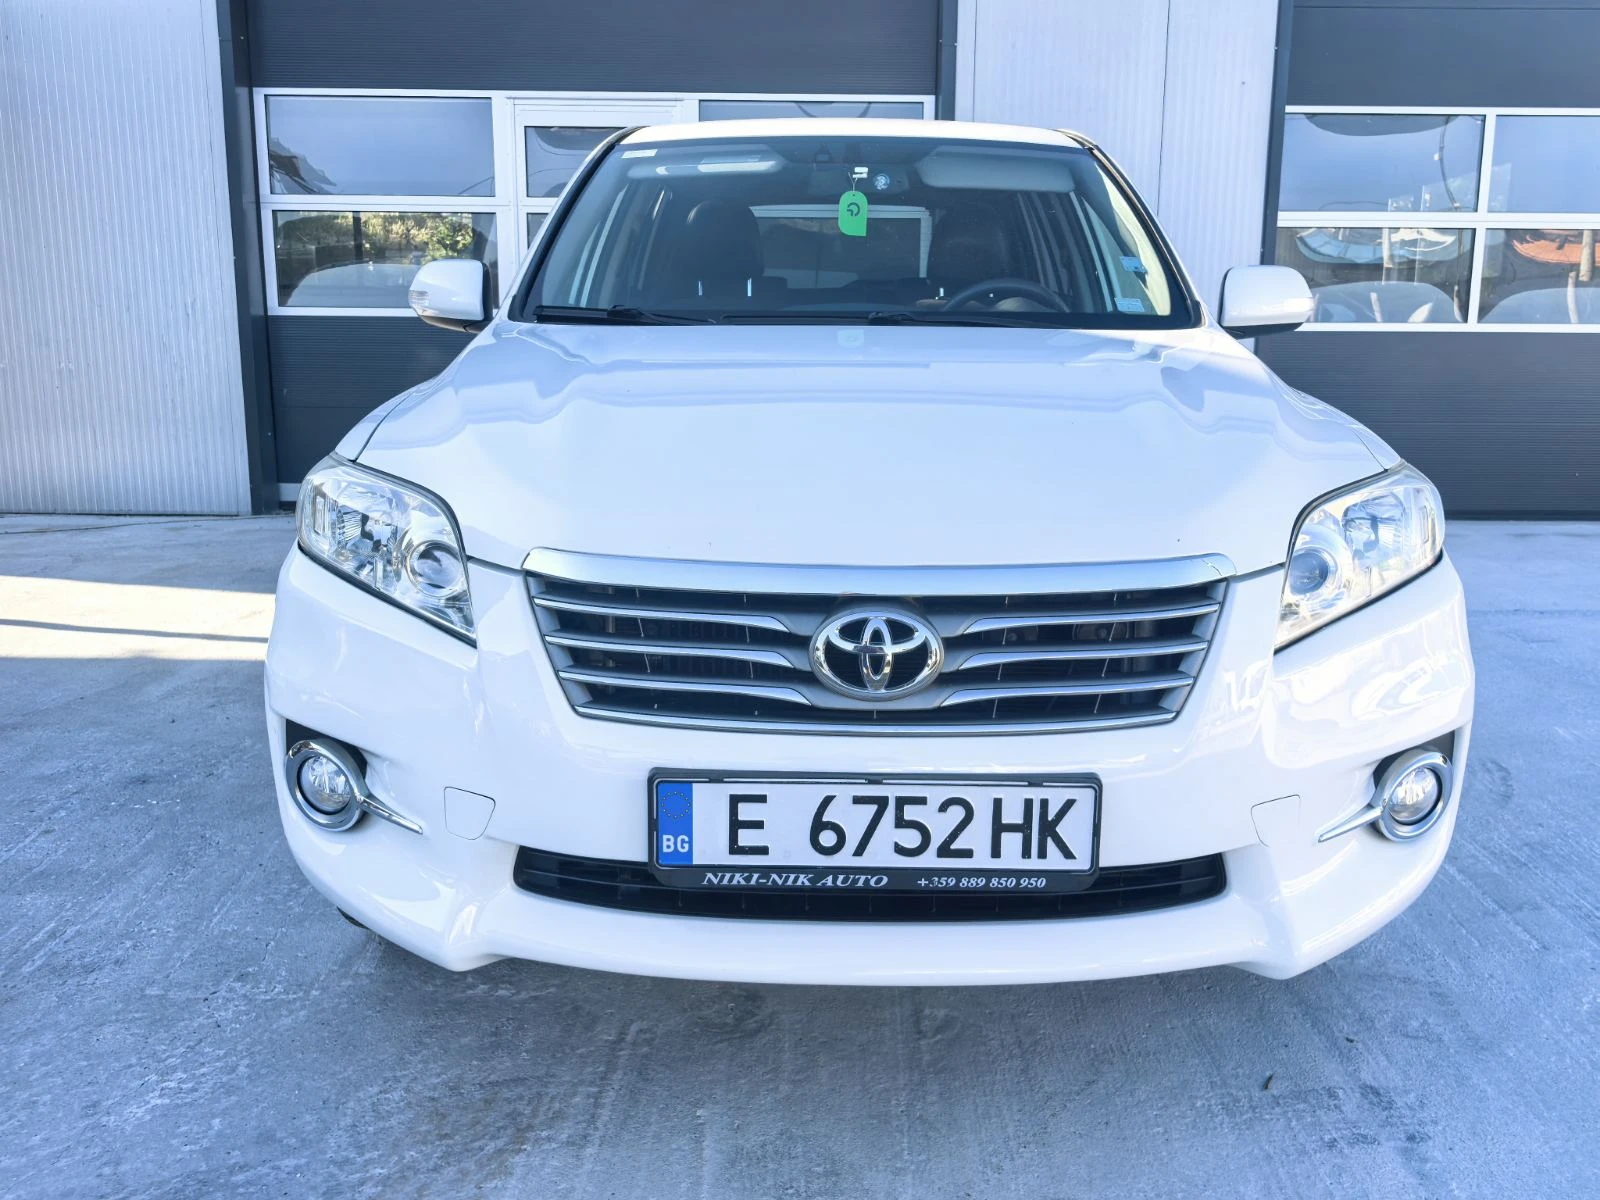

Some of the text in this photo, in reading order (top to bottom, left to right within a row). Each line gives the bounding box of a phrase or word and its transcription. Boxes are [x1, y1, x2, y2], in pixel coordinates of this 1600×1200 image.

[728, 793, 1078, 860] E 6752 HK
[662, 834, 690, 853] BG
[701, 872, 889, 887] NIKI-NIK AUTO
[917, 877, 1047, 888] +359 889 850 950
